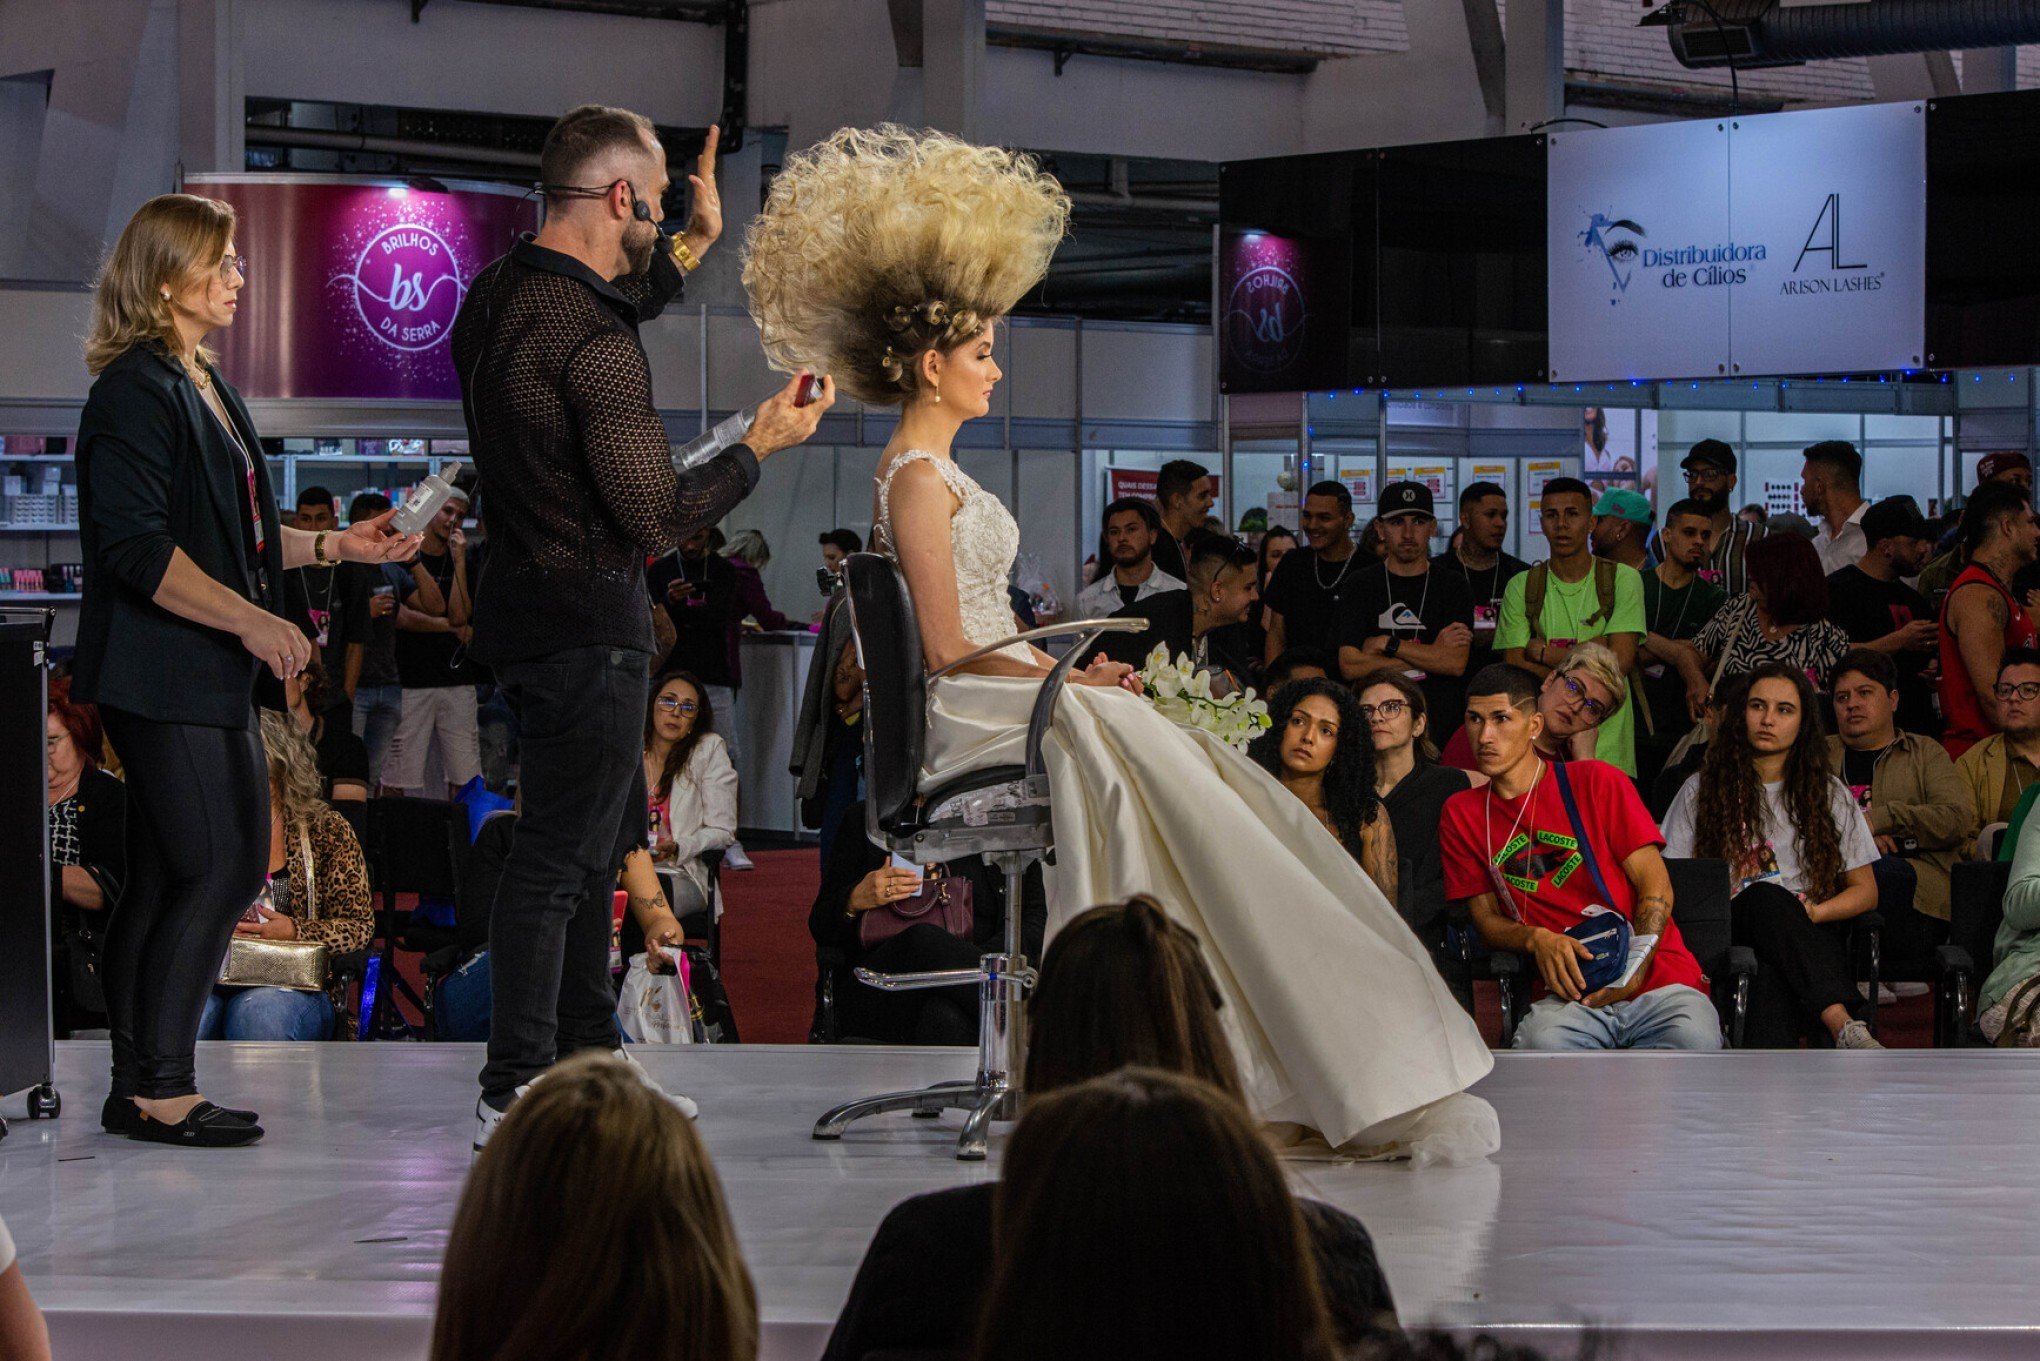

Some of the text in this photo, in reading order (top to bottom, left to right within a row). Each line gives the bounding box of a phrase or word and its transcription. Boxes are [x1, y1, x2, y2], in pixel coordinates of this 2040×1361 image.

[381, 233, 438, 255] BRILHOS
[1643, 242, 1767, 268] Distribuidora
[389, 263, 427, 311] bs
[1663, 265, 1747, 288] de Cílios
[1779, 280, 1831, 295] ARISON
[380, 317, 441, 342] DA SERRA
[1539, 831, 1577, 848] LACOSTE
[1553, 852, 1581, 887] LACOSTE
